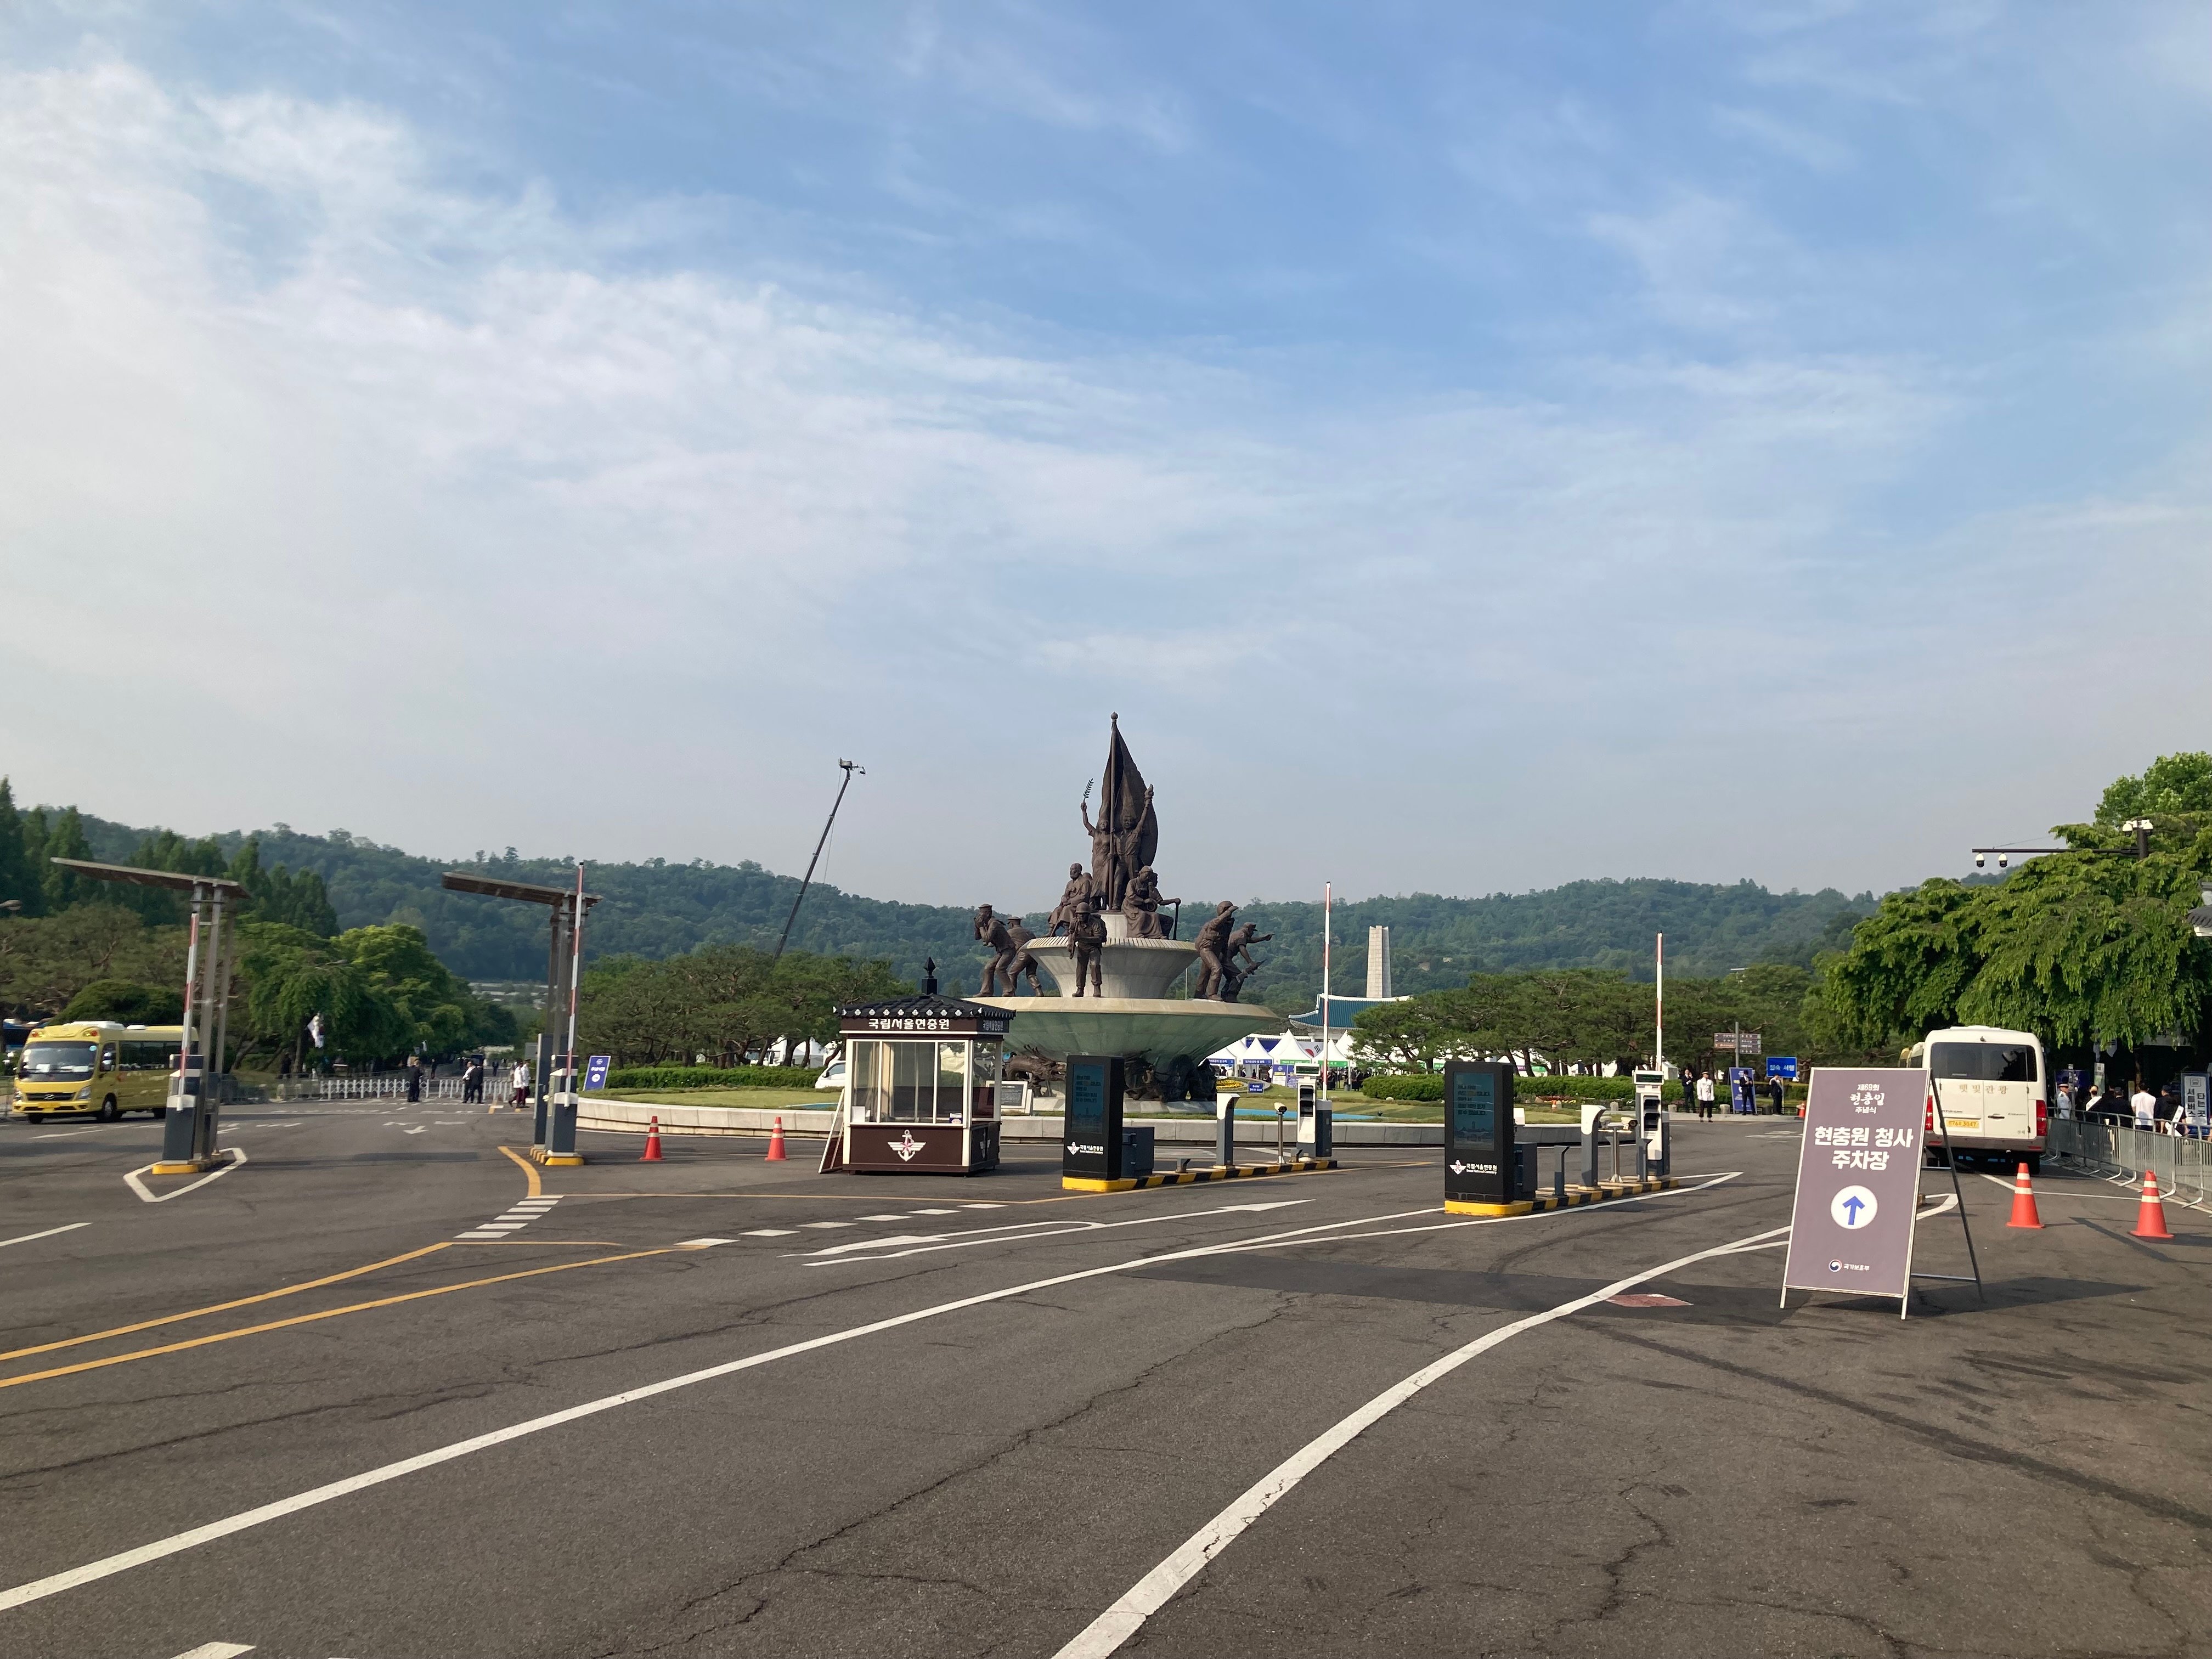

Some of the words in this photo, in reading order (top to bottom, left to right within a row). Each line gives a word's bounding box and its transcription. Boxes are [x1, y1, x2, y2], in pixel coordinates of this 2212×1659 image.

[868, 1018, 950, 1030] 국립서울현충원
[1849, 1092, 1885, 1106] 현충일
[1855, 1106, 1877, 1114] 추념식
[1815, 1126, 1870, 1147] 현충원
[1875, 1127, 1914, 1148] 청사
[1832, 1150, 1890, 1171] 주차장
